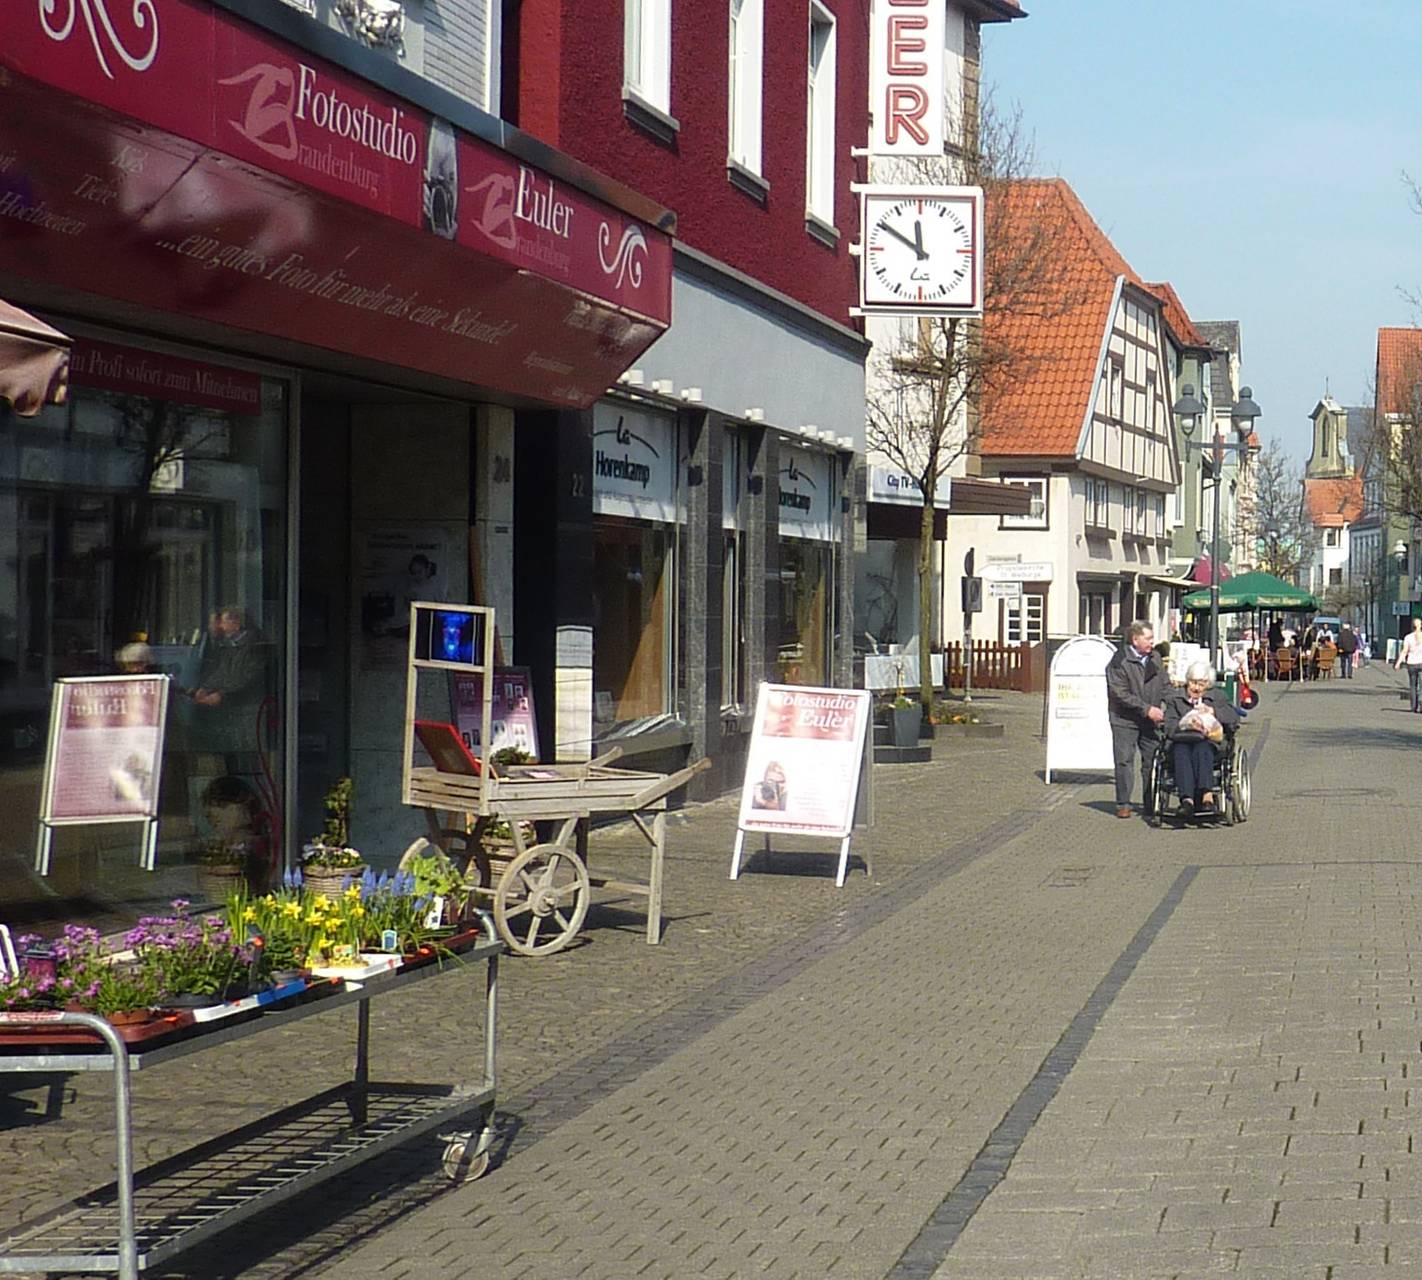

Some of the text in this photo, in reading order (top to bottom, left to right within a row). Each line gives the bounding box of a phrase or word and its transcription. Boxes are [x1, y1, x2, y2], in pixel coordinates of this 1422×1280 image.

[887, 0, 929, 145] ER
[295, 62, 417, 166] Fotostudio
[513, 164, 576, 240] Euler
[265, 253, 314, 290] Foto
[88, 349, 124, 379] Profi
[193, 369, 258, 404] Mitnehmen
[572, 472, 585, 498] 22
[595, 449, 651, 490] Horenkamp
